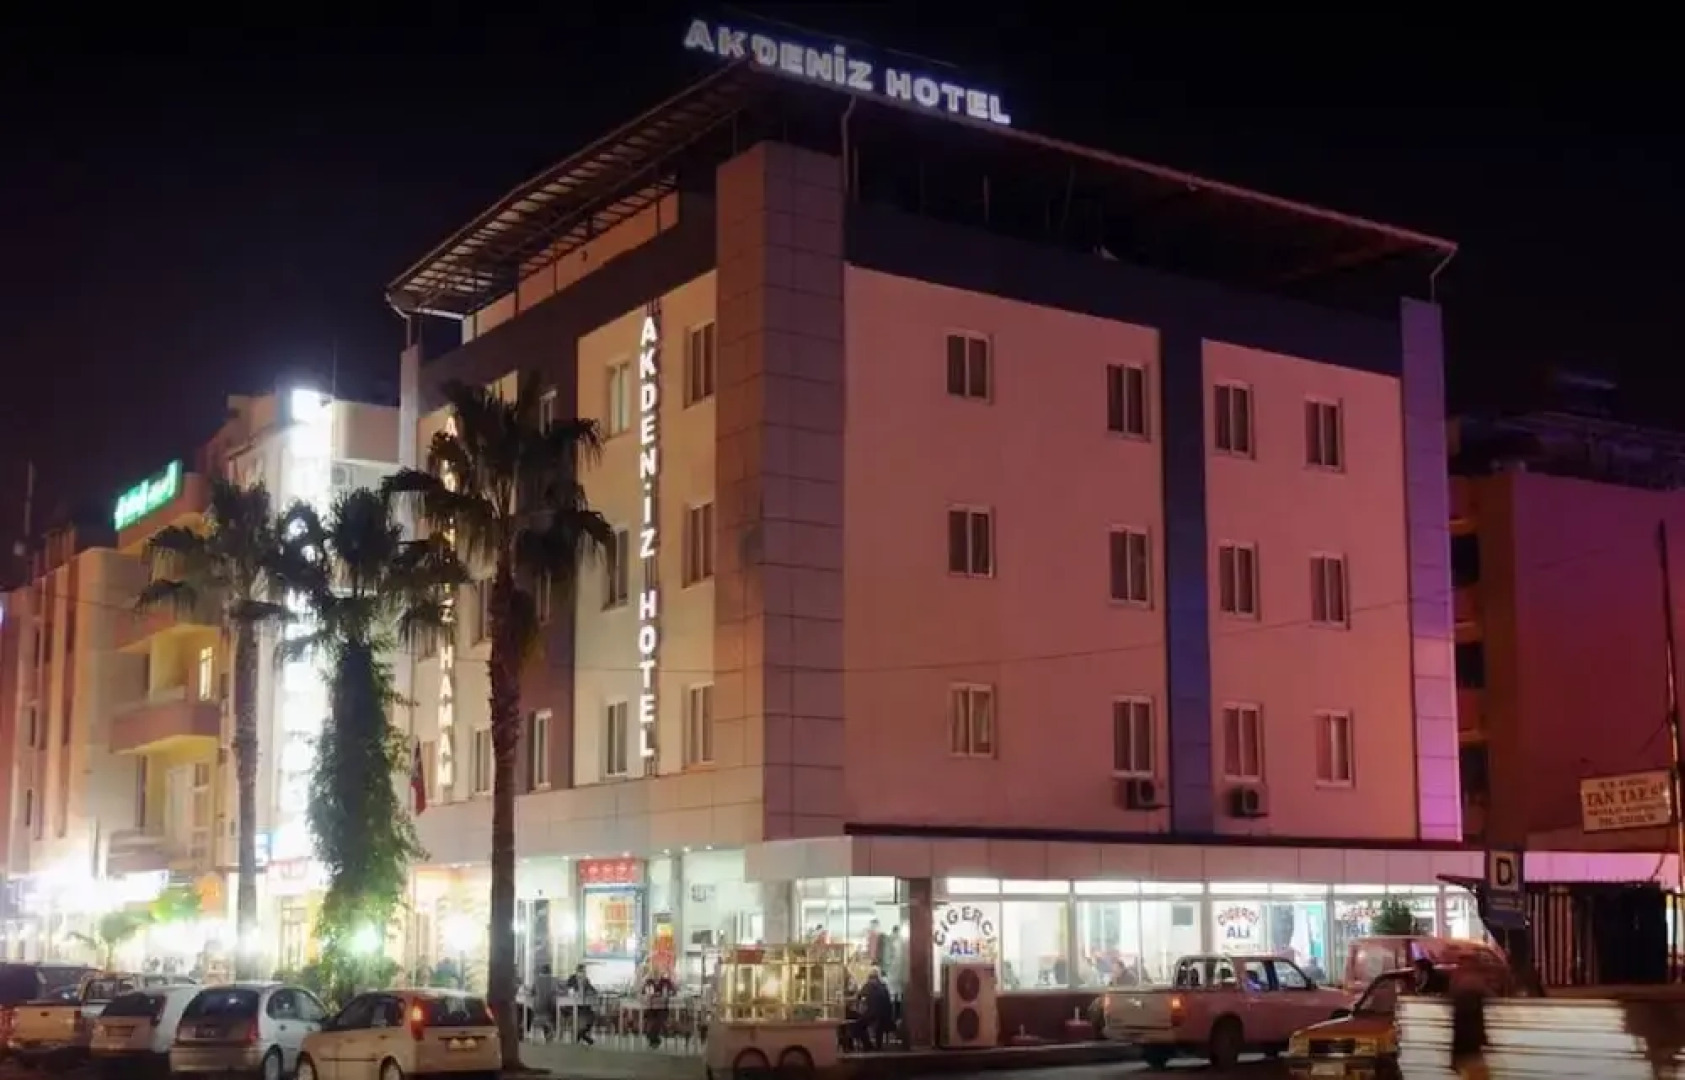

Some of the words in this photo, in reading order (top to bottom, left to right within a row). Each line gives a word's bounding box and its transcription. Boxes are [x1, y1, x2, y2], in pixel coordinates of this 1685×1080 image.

[684, 18, 873, 92] AKDENİZ
[885, 68, 1011, 125] HOTEL
[639, 315, 658, 559] AKDENİZ
[437, 645, 454, 786] HAMAM
[638, 589, 657, 757] HOTEL
[1496, 857, 1513, 886] D
